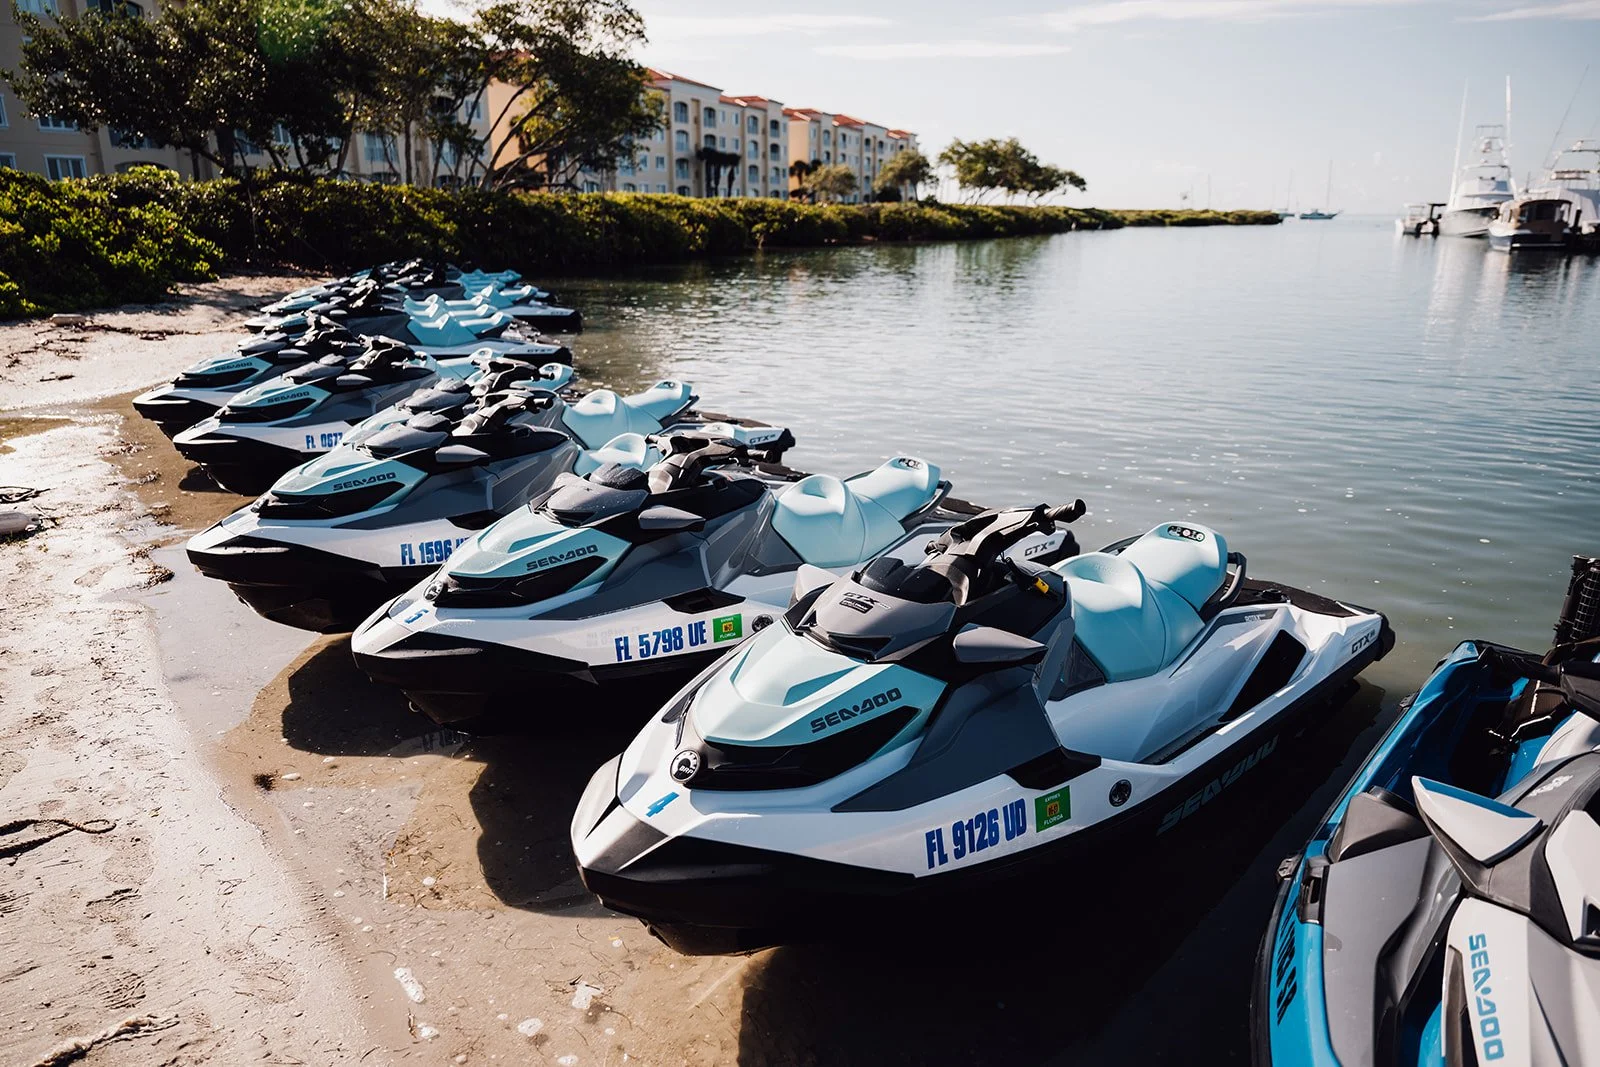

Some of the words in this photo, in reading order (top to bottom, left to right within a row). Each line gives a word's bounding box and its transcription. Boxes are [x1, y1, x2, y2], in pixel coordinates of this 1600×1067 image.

[305, 434, 317, 450] FL
[400, 543, 416, 566] FL
[418, 538, 453, 564] 1596
[1024, 542, 1048, 557] GTX
[614, 637, 633, 662] FL
[638, 626, 684, 659] 5798
[687, 620, 707, 648] UE
[679, 765, 694, 775] BRP
[645, 791, 680, 818] 4
[925, 827, 949, 870] FL
[952, 808, 1000, 860] 9126
[1002, 798, 1027, 842] UD
